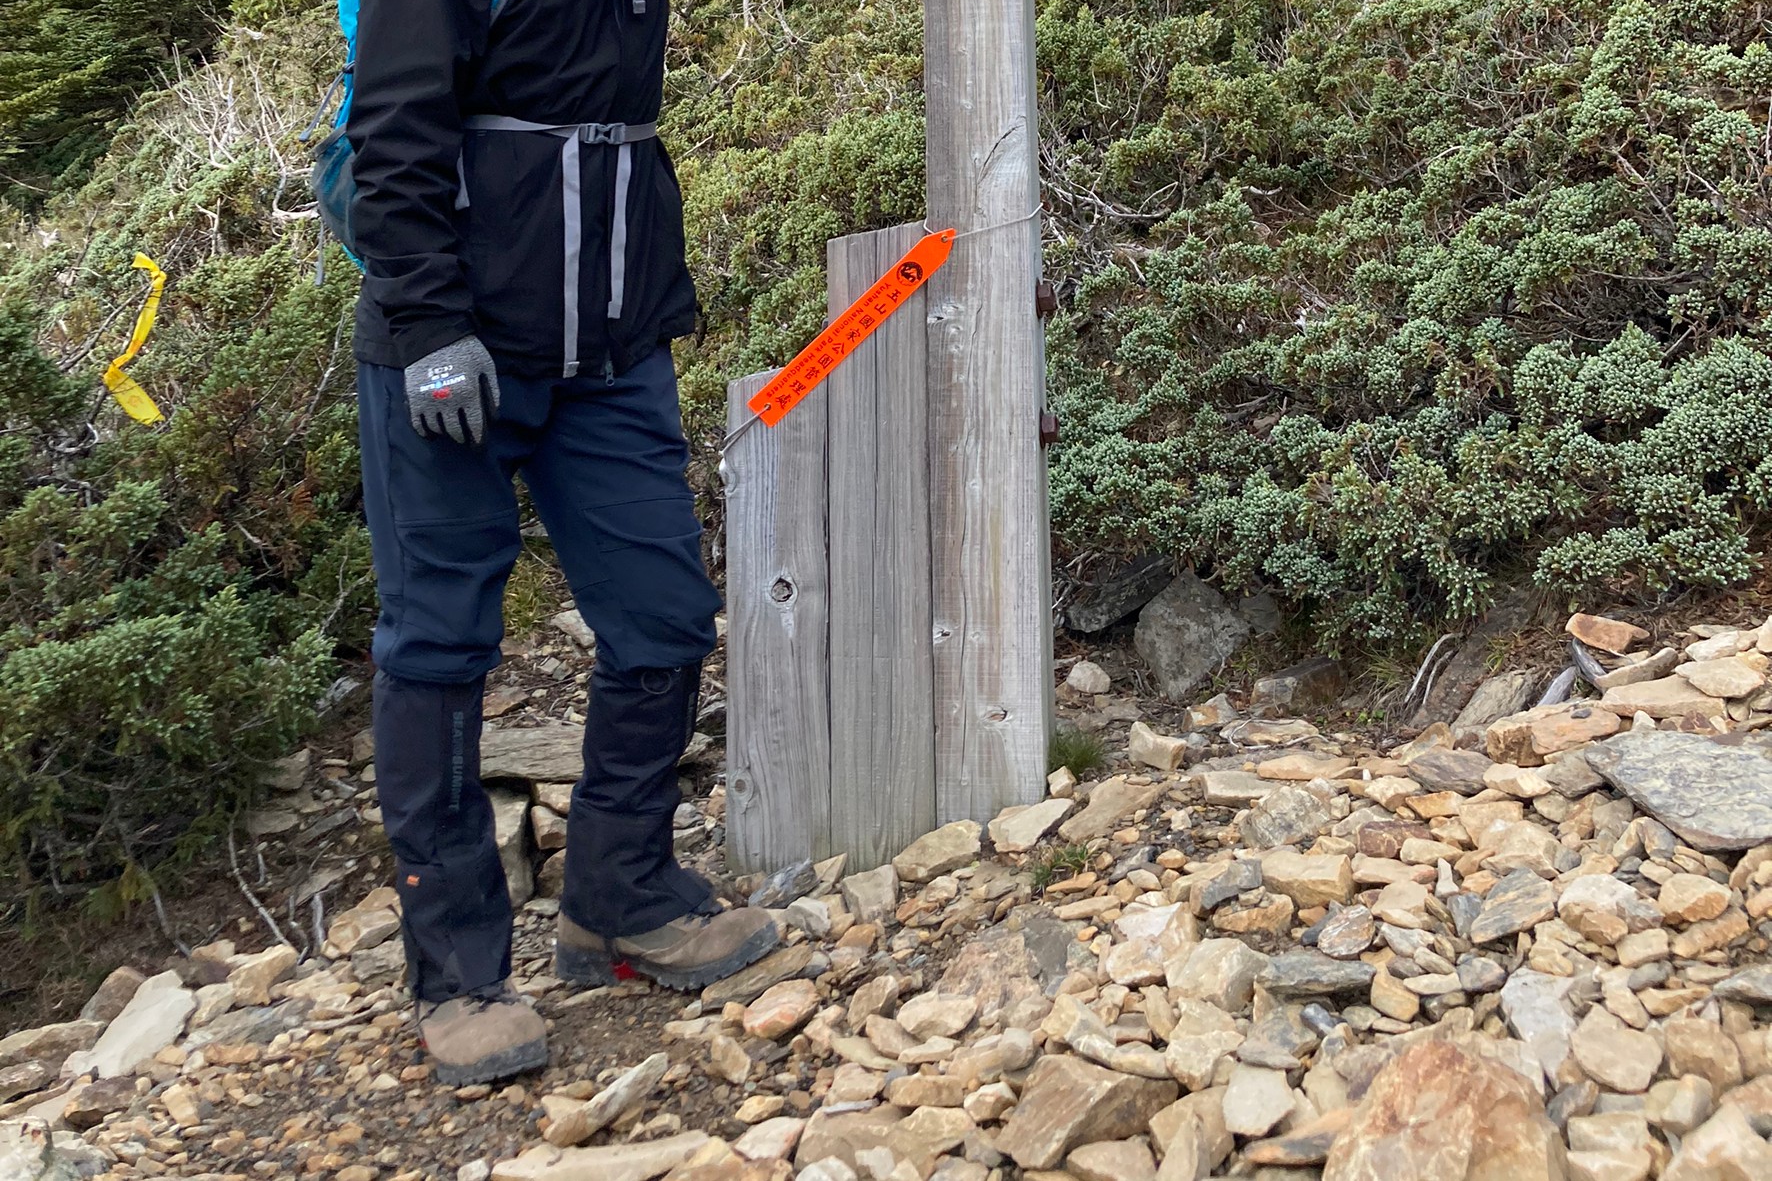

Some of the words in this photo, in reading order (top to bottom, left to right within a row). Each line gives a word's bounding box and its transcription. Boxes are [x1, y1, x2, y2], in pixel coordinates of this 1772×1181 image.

[864, 282, 892, 307] Yushan
[832, 307, 864, 337] National
[775, 289, 902, 409] 玉山國家公園管理處
[814, 336, 834, 352] Park
[766, 352, 816, 398] Headquarters
